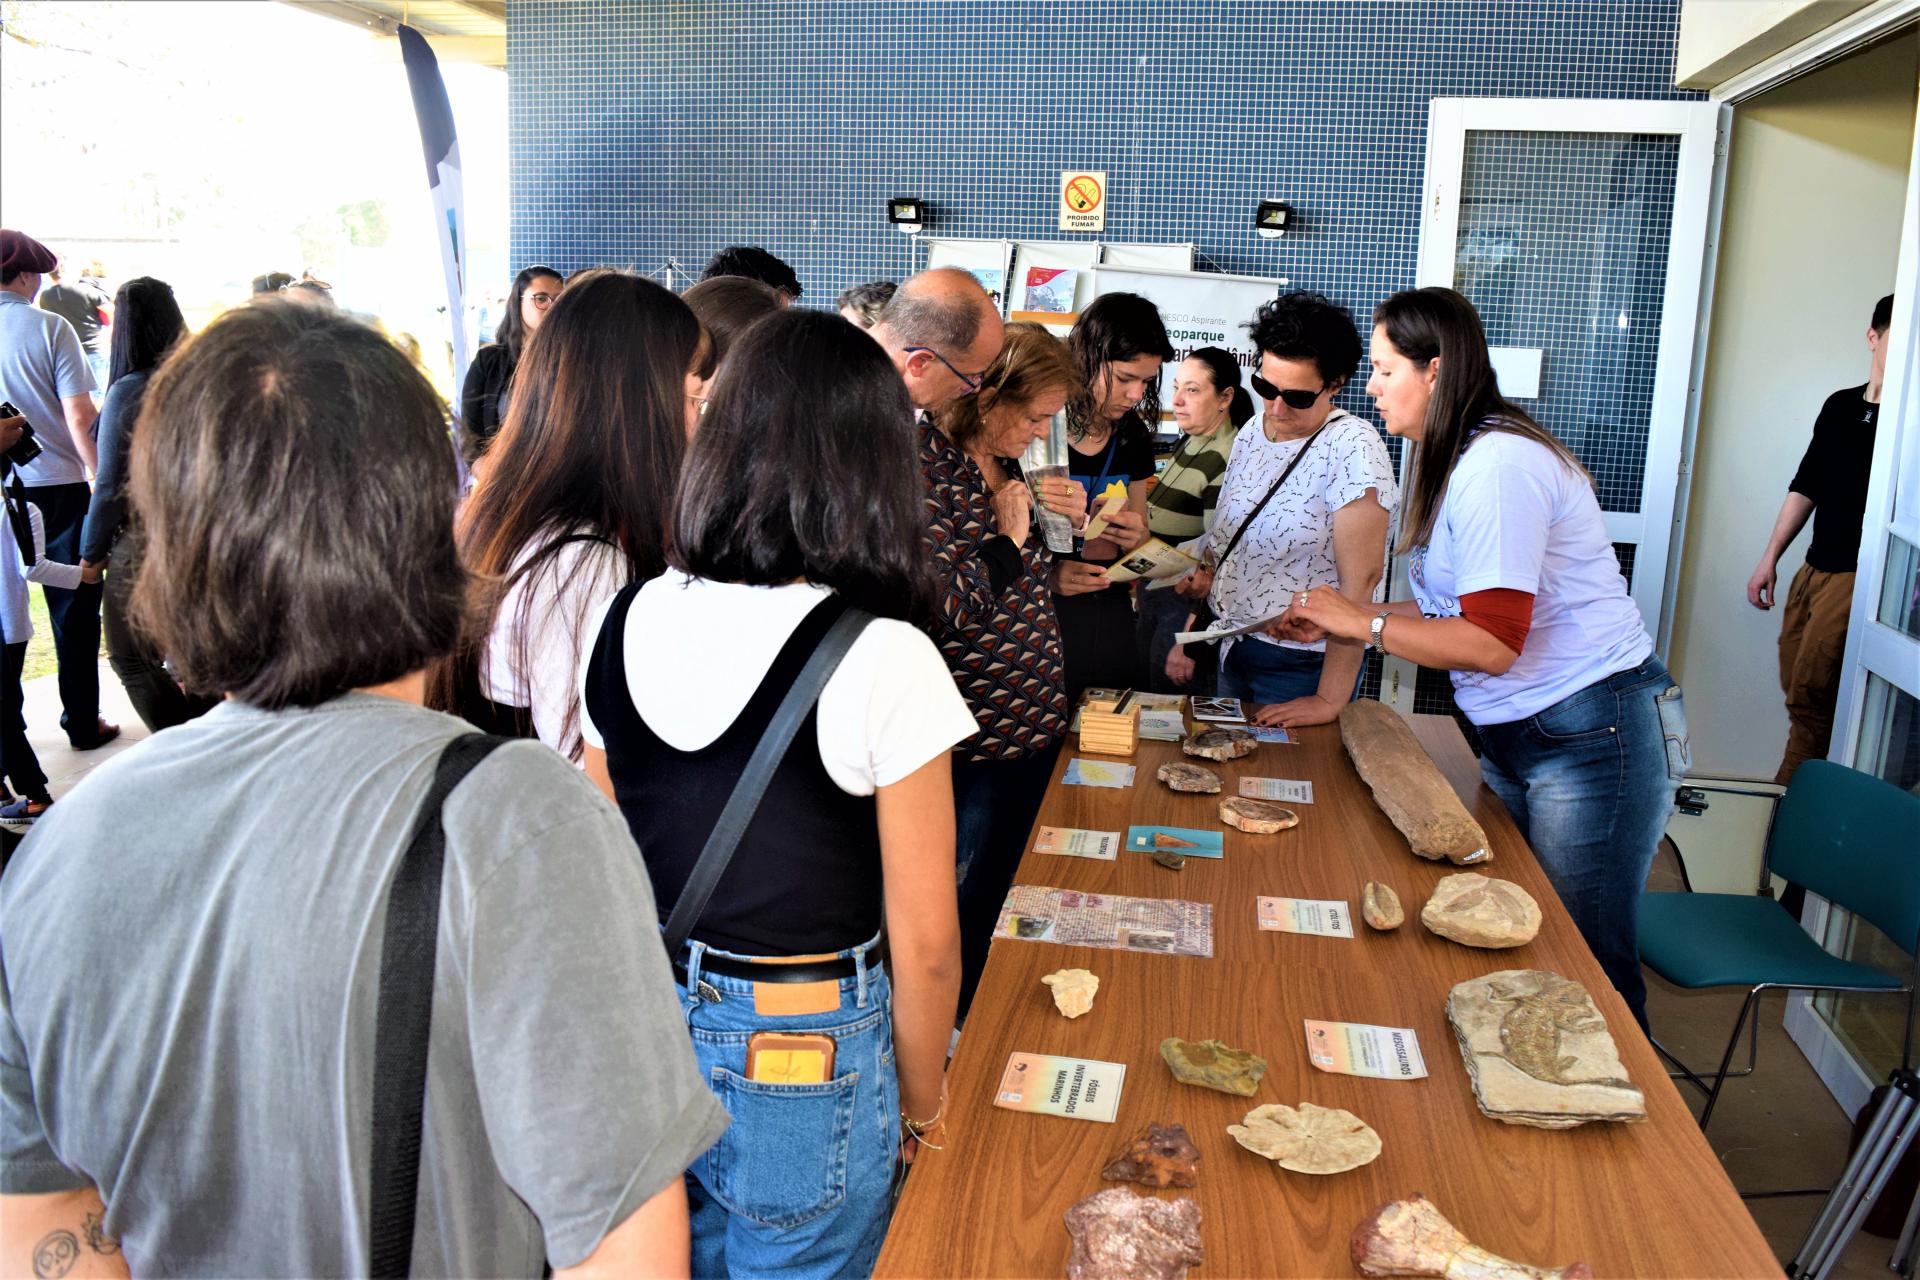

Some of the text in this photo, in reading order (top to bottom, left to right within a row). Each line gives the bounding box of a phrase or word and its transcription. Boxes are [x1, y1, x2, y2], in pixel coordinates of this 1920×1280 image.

[1160, 312, 1227, 327] NESCO Aspirante
[1165, 328, 1225, 343] eoparque
[1391, 1031, 1412, 1076] MESOSSAUROS
[1050, 1069, 1067, 1104] MARINHOS
[1065, 1064, 1086, 1114] INVERTEBRADOS
[1085, 1079, 1100, 1103] FÓSSEIS
